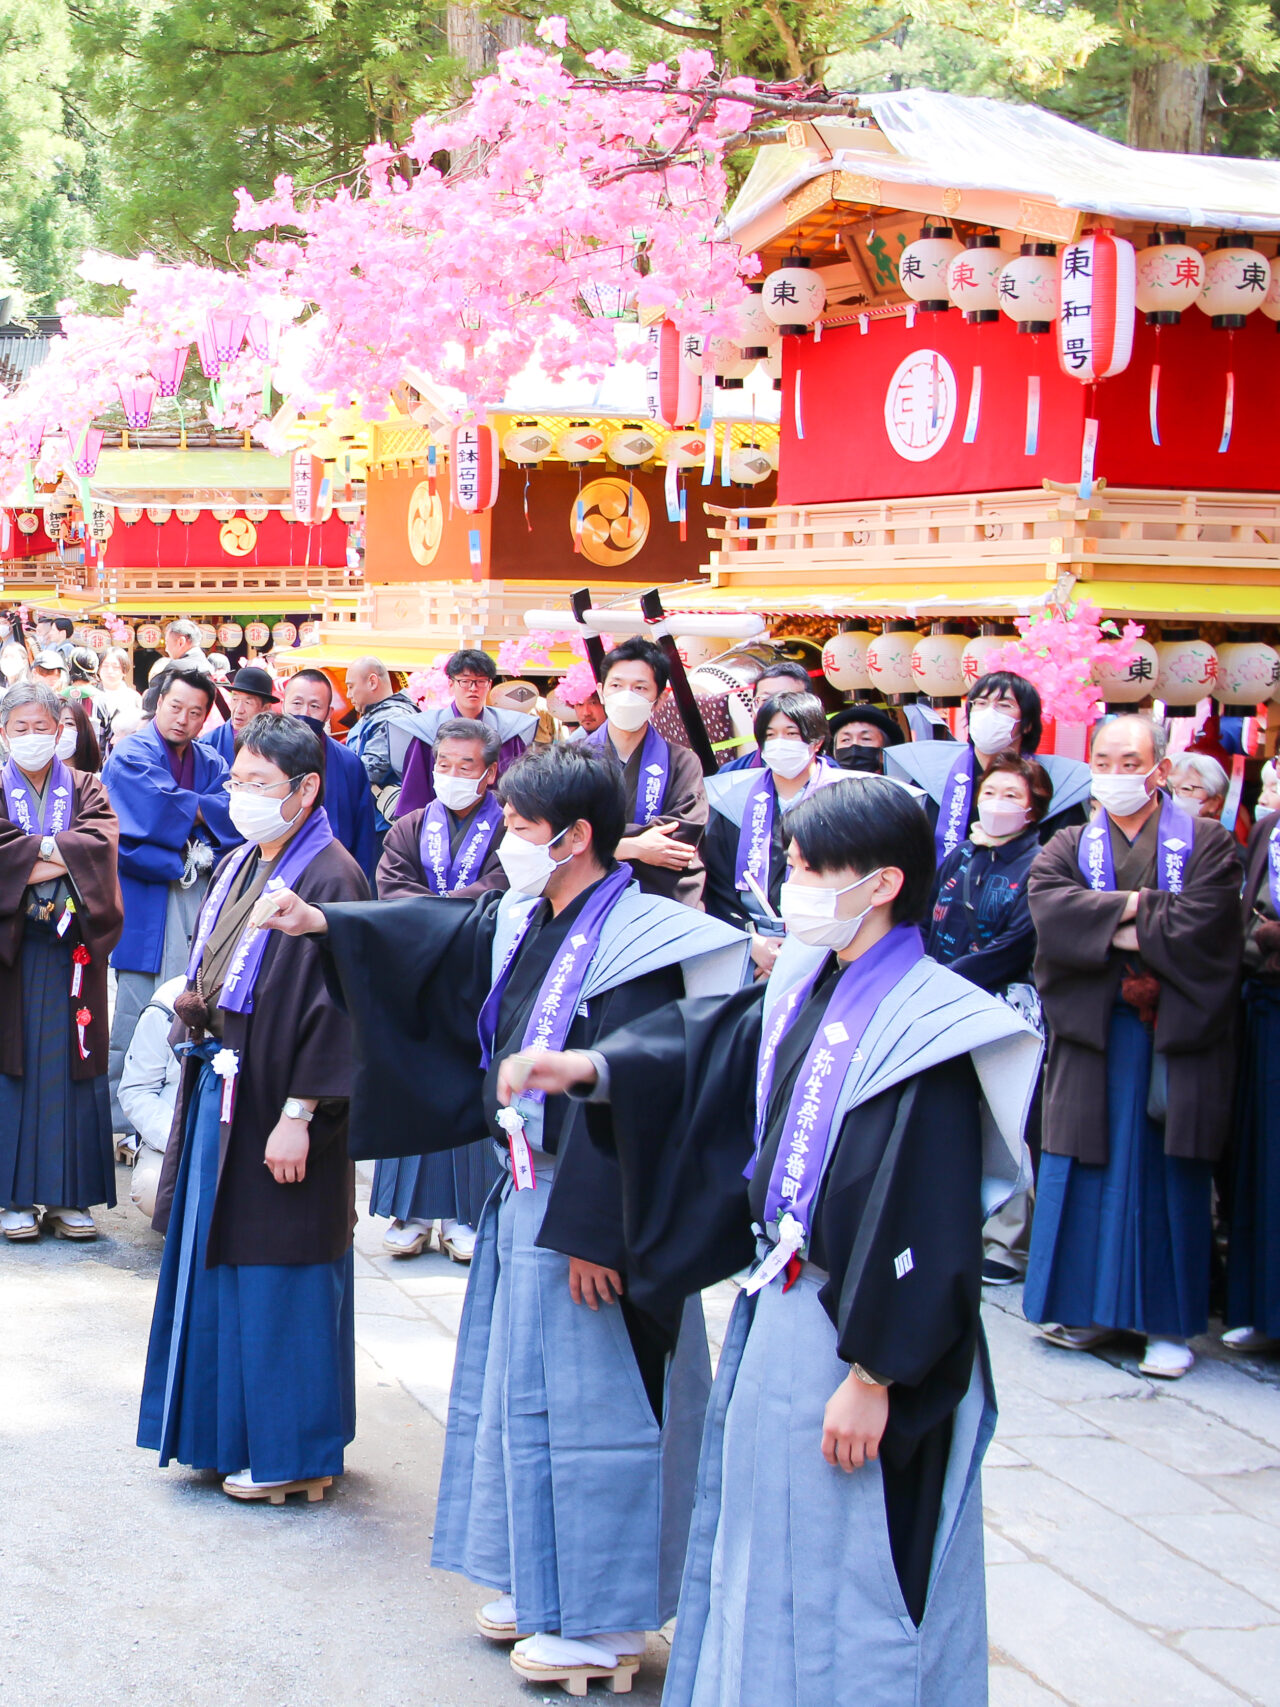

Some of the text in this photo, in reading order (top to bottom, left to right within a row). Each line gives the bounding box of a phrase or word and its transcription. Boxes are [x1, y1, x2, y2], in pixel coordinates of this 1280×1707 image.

[902, 254, 925, 281] 東
[952, 261, 979, 291] 東
[1170, 257, 1201, 288] 東
[1235, 262, 1266, 293] 東
[771, 280, 800, 307] 東
[1000, 272, 1020, 301] 東
[684, 335, 703, 360] 東
[823, 649, 841, 676] 東
[867, 649, 884, 676] 東
[963, 652, 981, 684] 東
[1122, 655, 1154, 684] 東
[1198, 655, 1219, 685] 東
[780, 1047, 836, 1206] 弥生祭当番町
